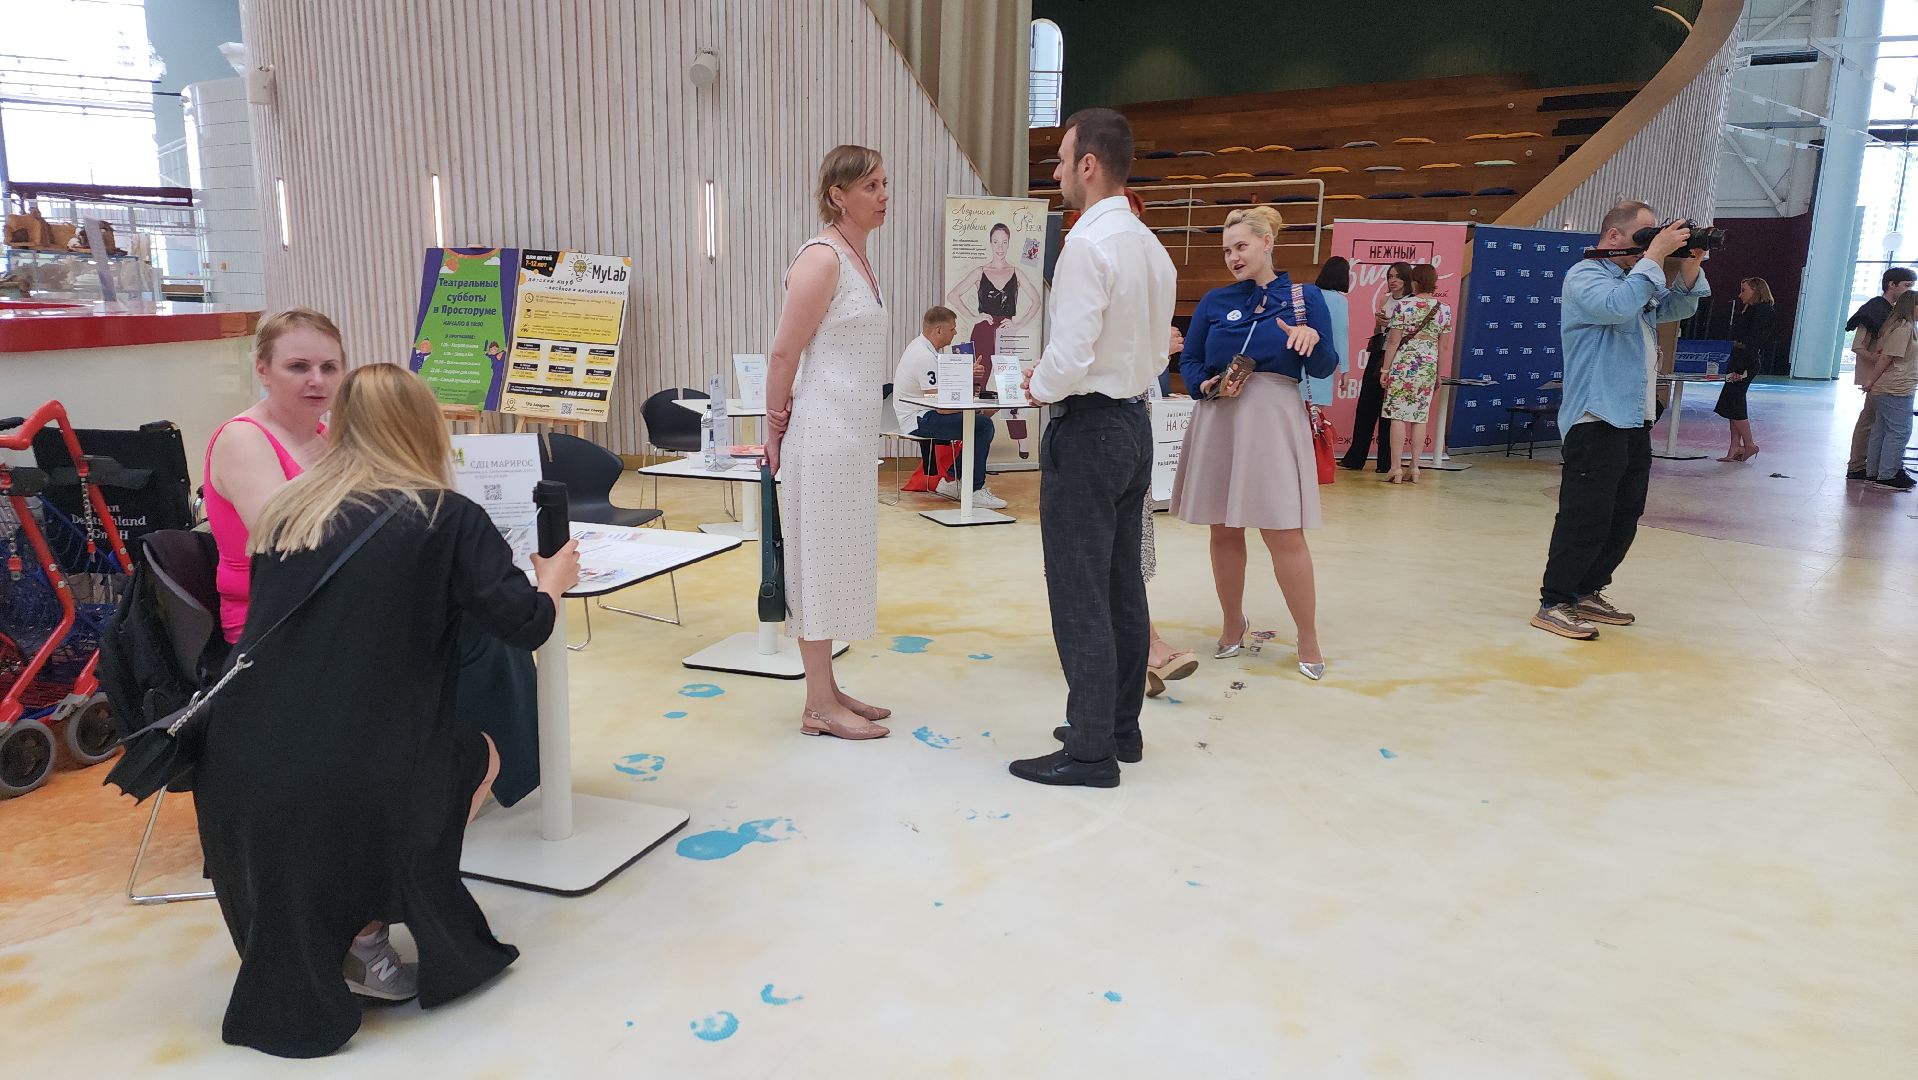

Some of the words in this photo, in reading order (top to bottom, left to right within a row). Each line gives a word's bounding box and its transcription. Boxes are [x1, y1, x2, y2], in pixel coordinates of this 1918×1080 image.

[1369, 244, 1417, 260] НЕЖНЫЙ
[592, 264, 627, 283] MyLab
[439, 278, 499, 289] Театральные
[446, 292, 487, 304] субботы
[441, 305, 497, 317] Просторуме
[927, 370, 937, 385] 3
[470, 460, 489, 470] СДЦ
[490, 459, 534, 468] МАРИРОС
